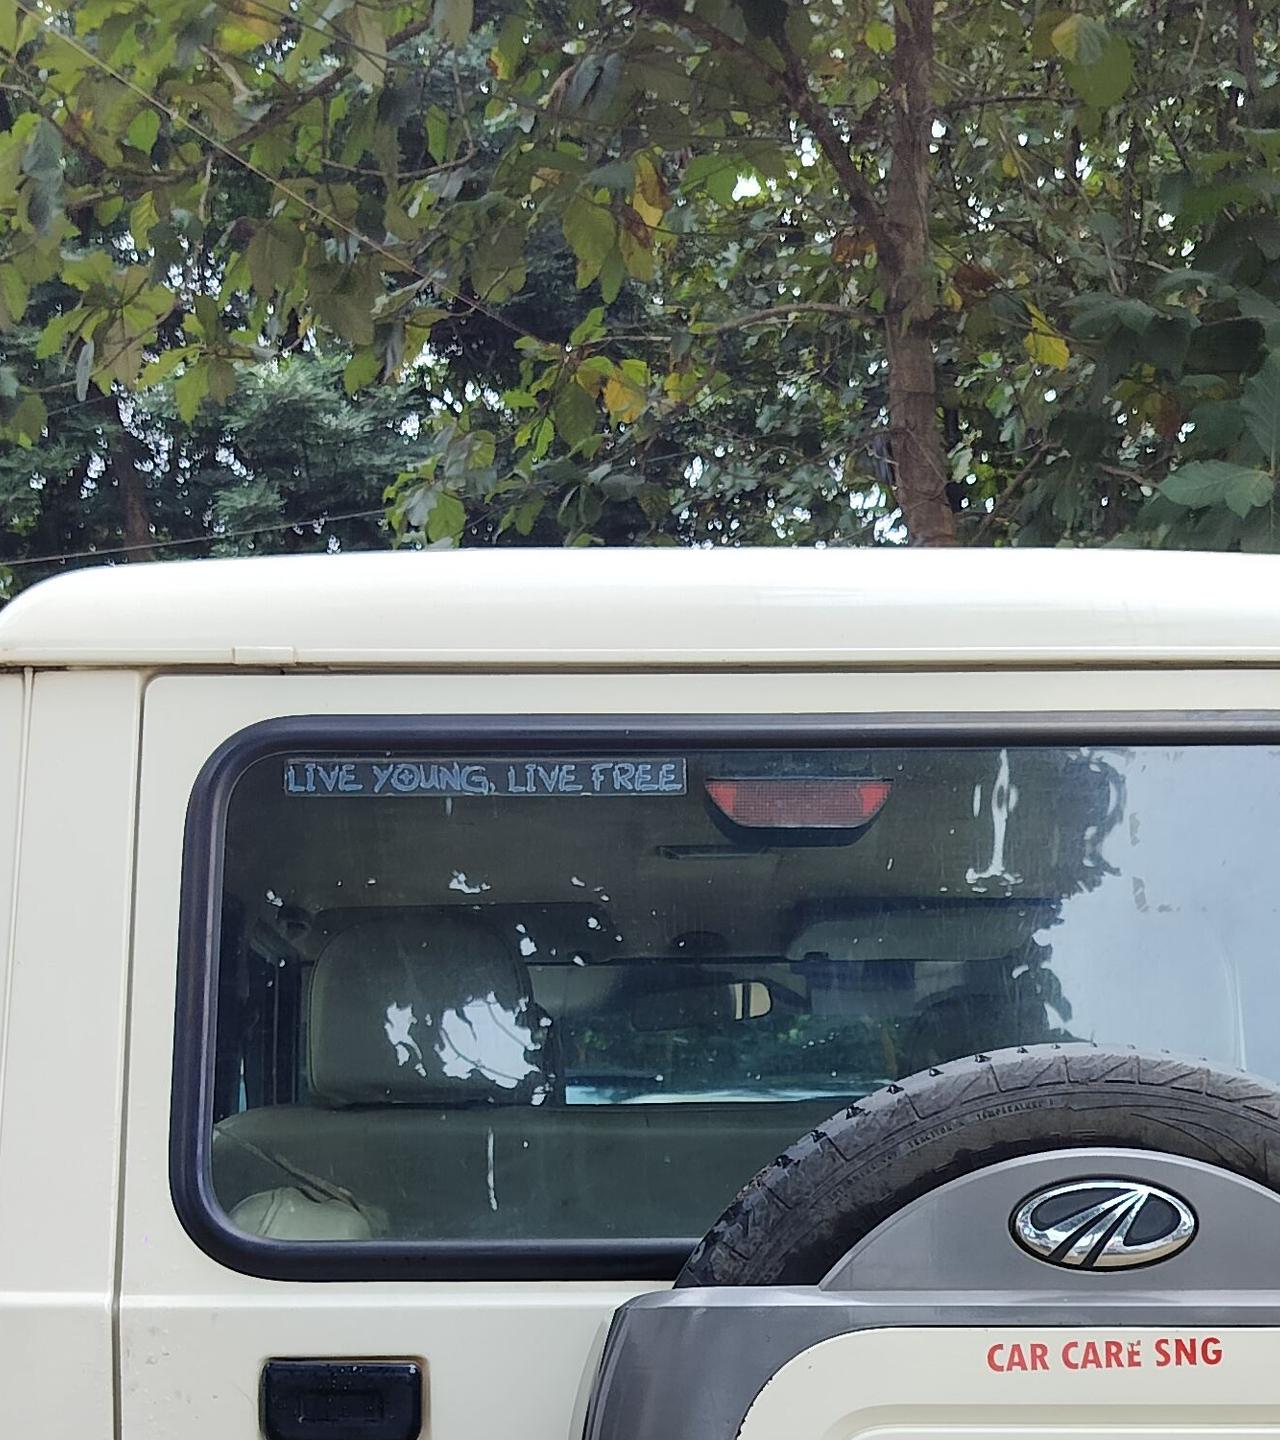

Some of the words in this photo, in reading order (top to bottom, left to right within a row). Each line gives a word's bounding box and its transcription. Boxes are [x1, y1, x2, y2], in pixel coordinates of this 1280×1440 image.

[287, 763, 363, 793] LIVE
[372, 762, 496, 795] YOUNG,
[507, 764, 582, 793] LIVE
[591, 762, 683, 792] FREE
[987, 1343, 1049, 1372] CAR
[1061, 1339, 1142, 1370] CARE
[1154, 1336, 1223, 1367] SNG
